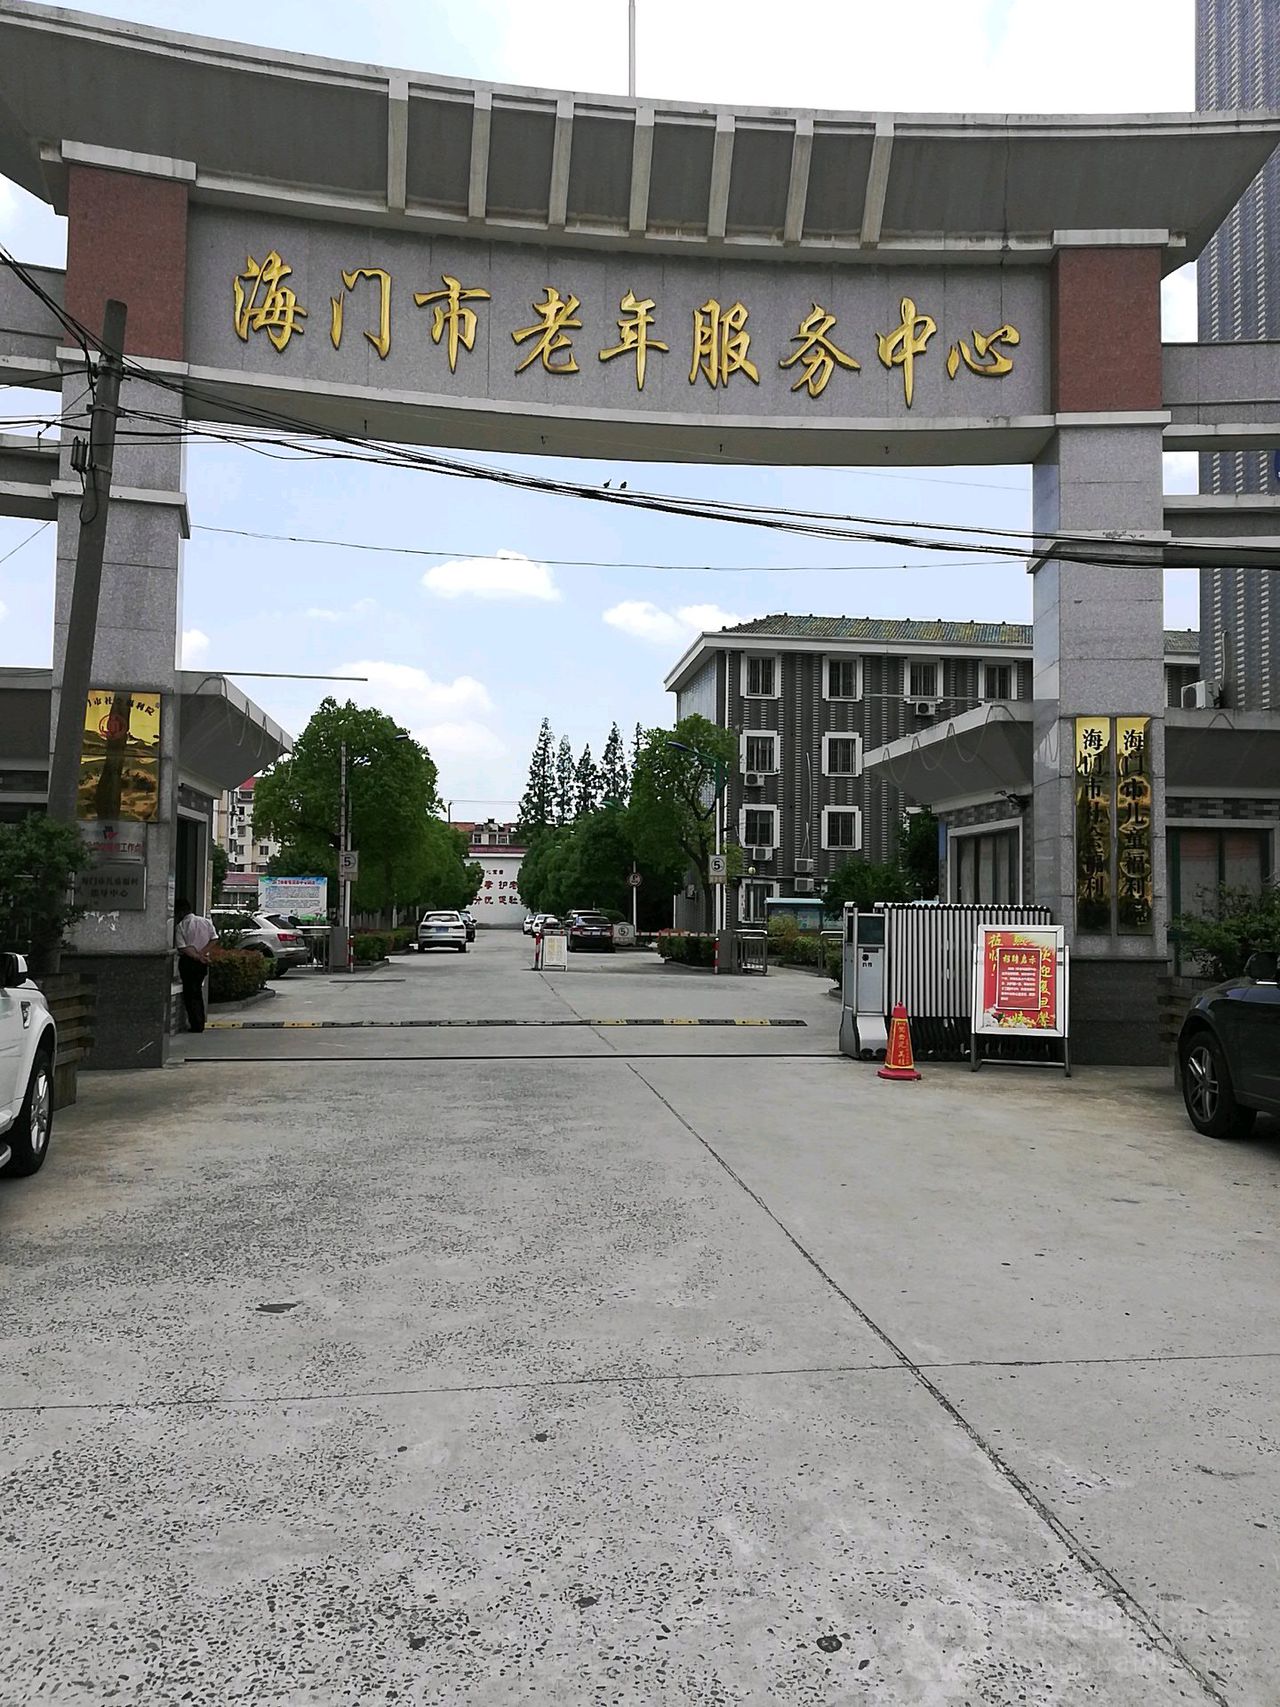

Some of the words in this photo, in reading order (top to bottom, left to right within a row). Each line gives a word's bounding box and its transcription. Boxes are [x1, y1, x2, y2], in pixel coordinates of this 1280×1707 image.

[233, 249, 1021, 409] 海门市老年服务中心
[343, 856, 352, 867] 5
[713, 860, 721, 871] 5
[1082, 728, 1104, 922] 海门市社会福利
[1123, 729, 1147, 922] 海门市儿童福利
